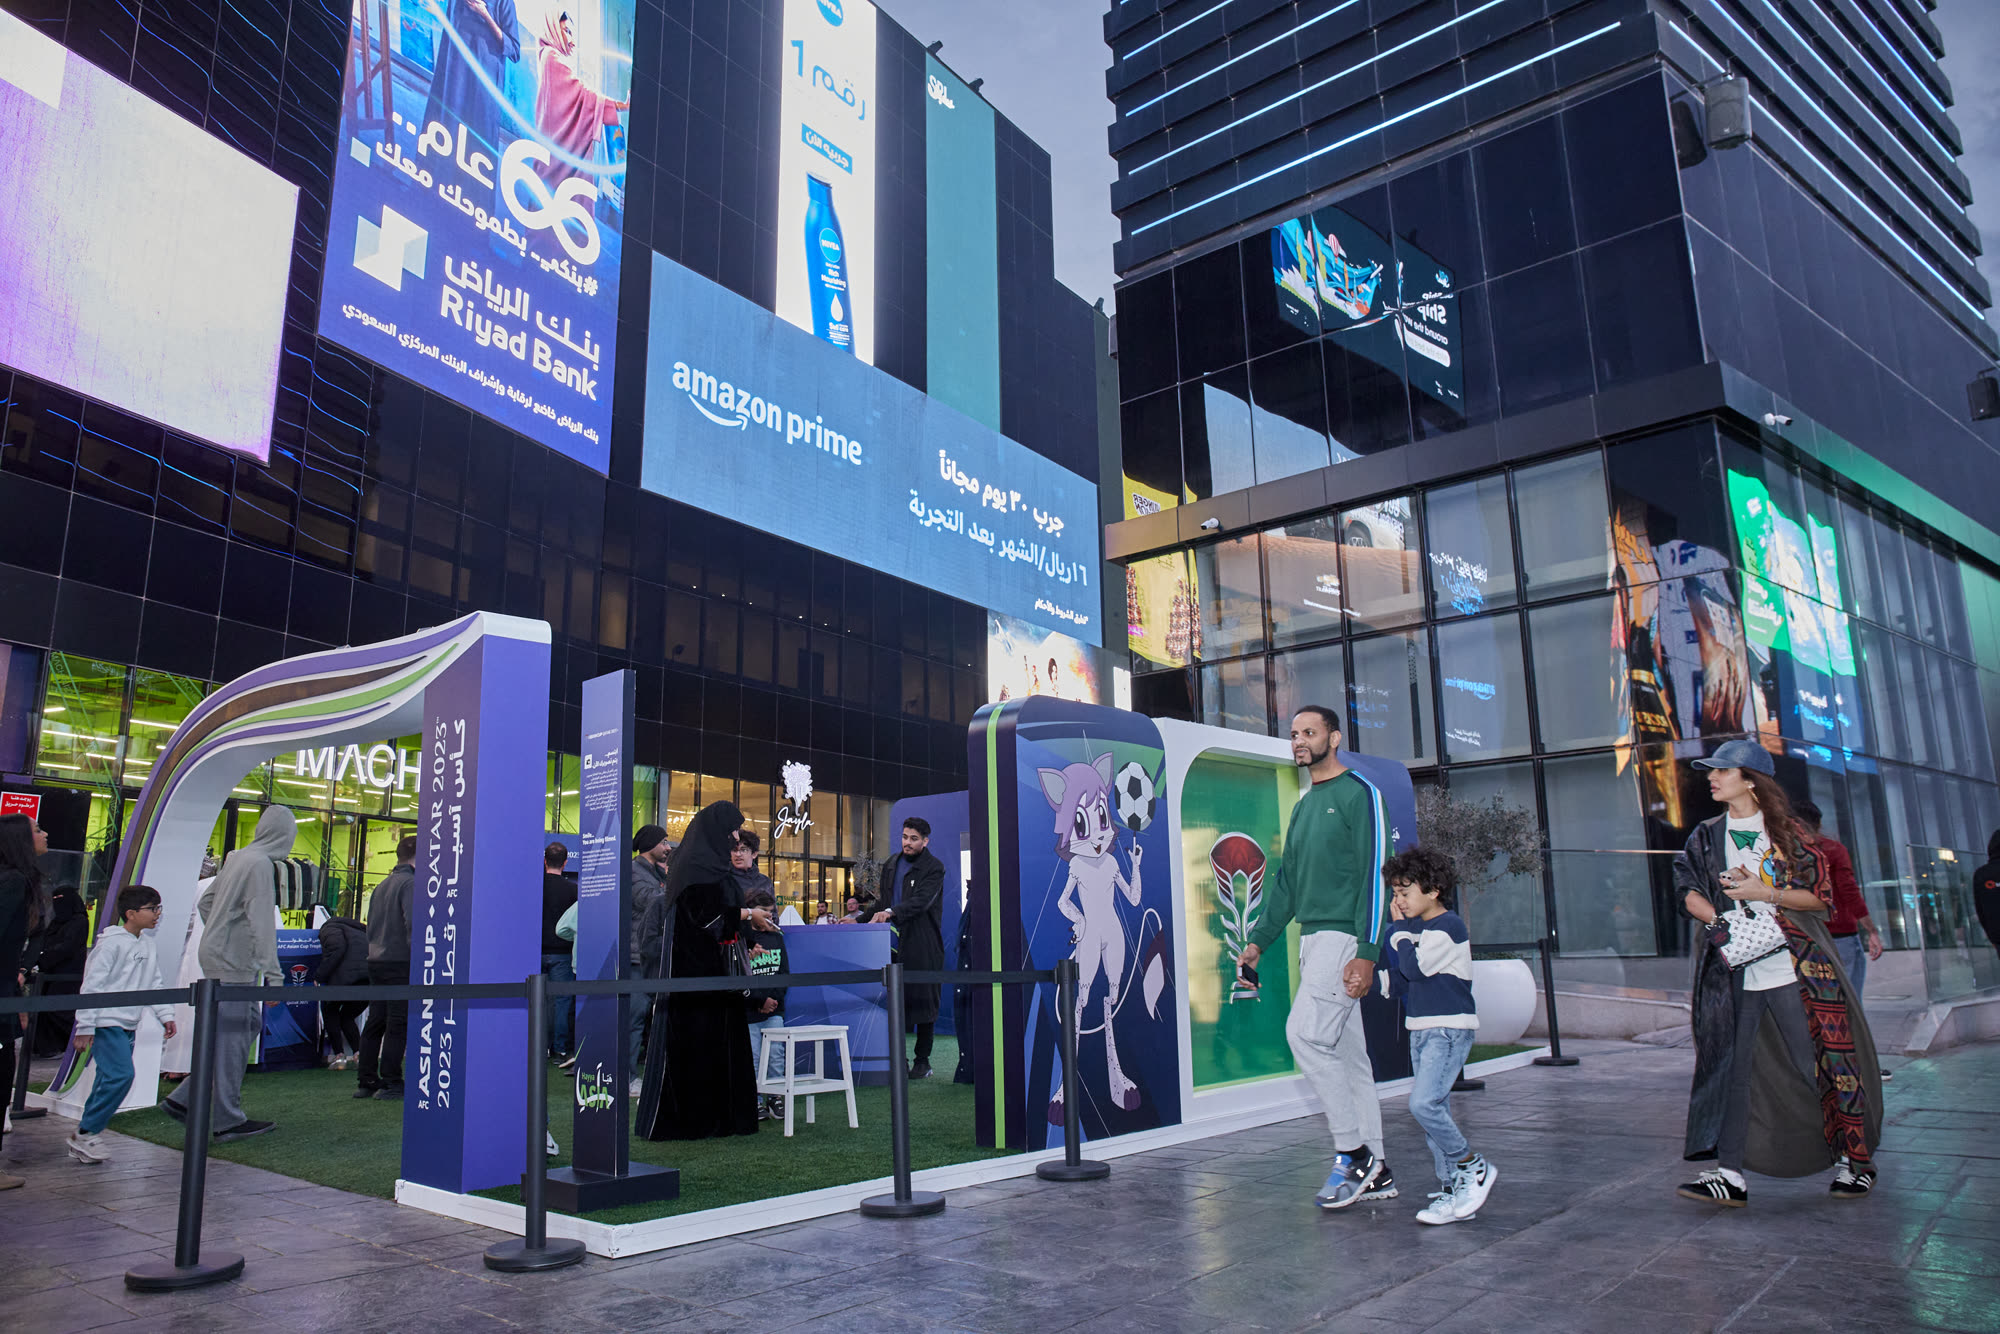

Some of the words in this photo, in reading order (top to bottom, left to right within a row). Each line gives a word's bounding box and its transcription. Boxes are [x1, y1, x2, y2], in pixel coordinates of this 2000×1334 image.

[813, 65, 866, 121] رقم
[376, 141, 433, 187] معك
[444, 255, 529, 321] الرياض
[342, 304, 397, 337] السعودي
[440, 284, 527, 360] Riyad
[532, 338, 597, 401] Bank
[536, 311, 600, 371] بنك
[398, 333, 440, 360] المركزي
[441, 353, 468, 374] البنك
[533, 402, 556, 421] خاضع
[557, 416, 583, 434] الرياض
[672, 361, 782, 432] amazon
[786, 409, 862, 466] prime
[583, 428, 599, 444] بنك
[909, 489, 964, 535] التجربة
[982, 484, 1007, 513] يوم
[968, 522, 995, 554] بعد
[1032, 507, 1065, 538] جرب
[295, 743, 422, 793] MACH
[449, 718, 466, 798] كأس
[446, 804, 464, 886] آسيا
[774, 806, 815, 839] Jayla
[427, 798, 443, 898] QATAR
[446, 888, 459, 898] AFC
[423, 924, 437, 986] CUP
[418, 998, 434, 1098] ASIAN
[437, 1032, 452, 1109] 2023
[418, 1099, 430, 1110] AFC
[580, 1084, 610, 1109] ASIA
